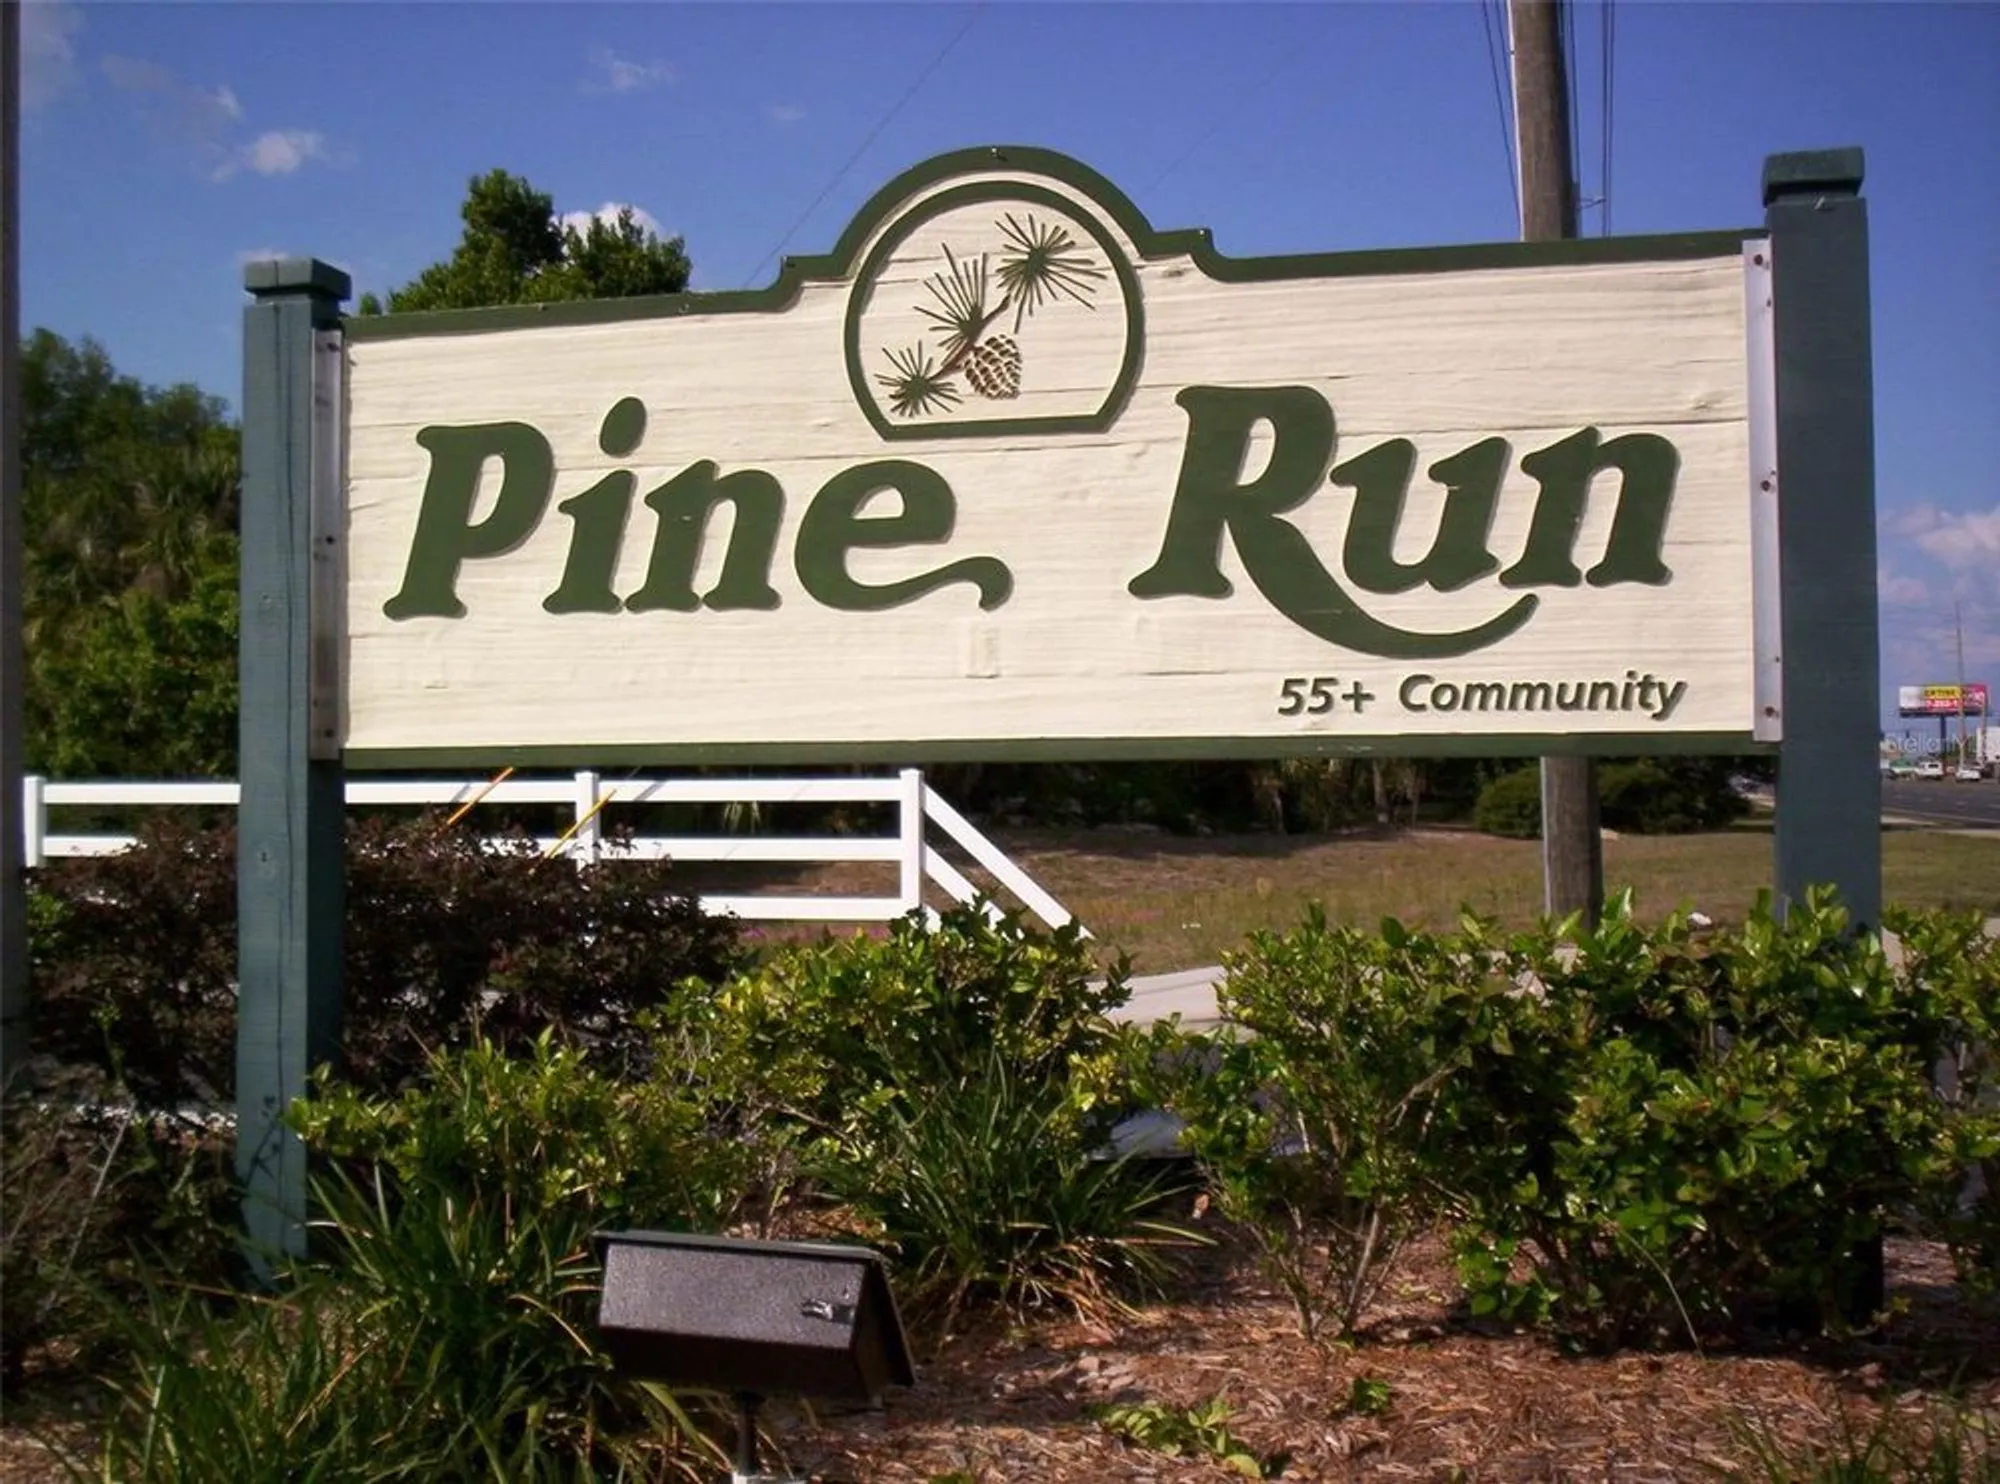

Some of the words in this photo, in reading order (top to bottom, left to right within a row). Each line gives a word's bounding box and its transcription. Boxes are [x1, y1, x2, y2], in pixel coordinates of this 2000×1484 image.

[383, 396, 1012, 620] Pine
[1128, 385, 1680, 660] Run
[1277, 677, 1375, 716] 55+
[1398, 670, 1688, 721] Community
